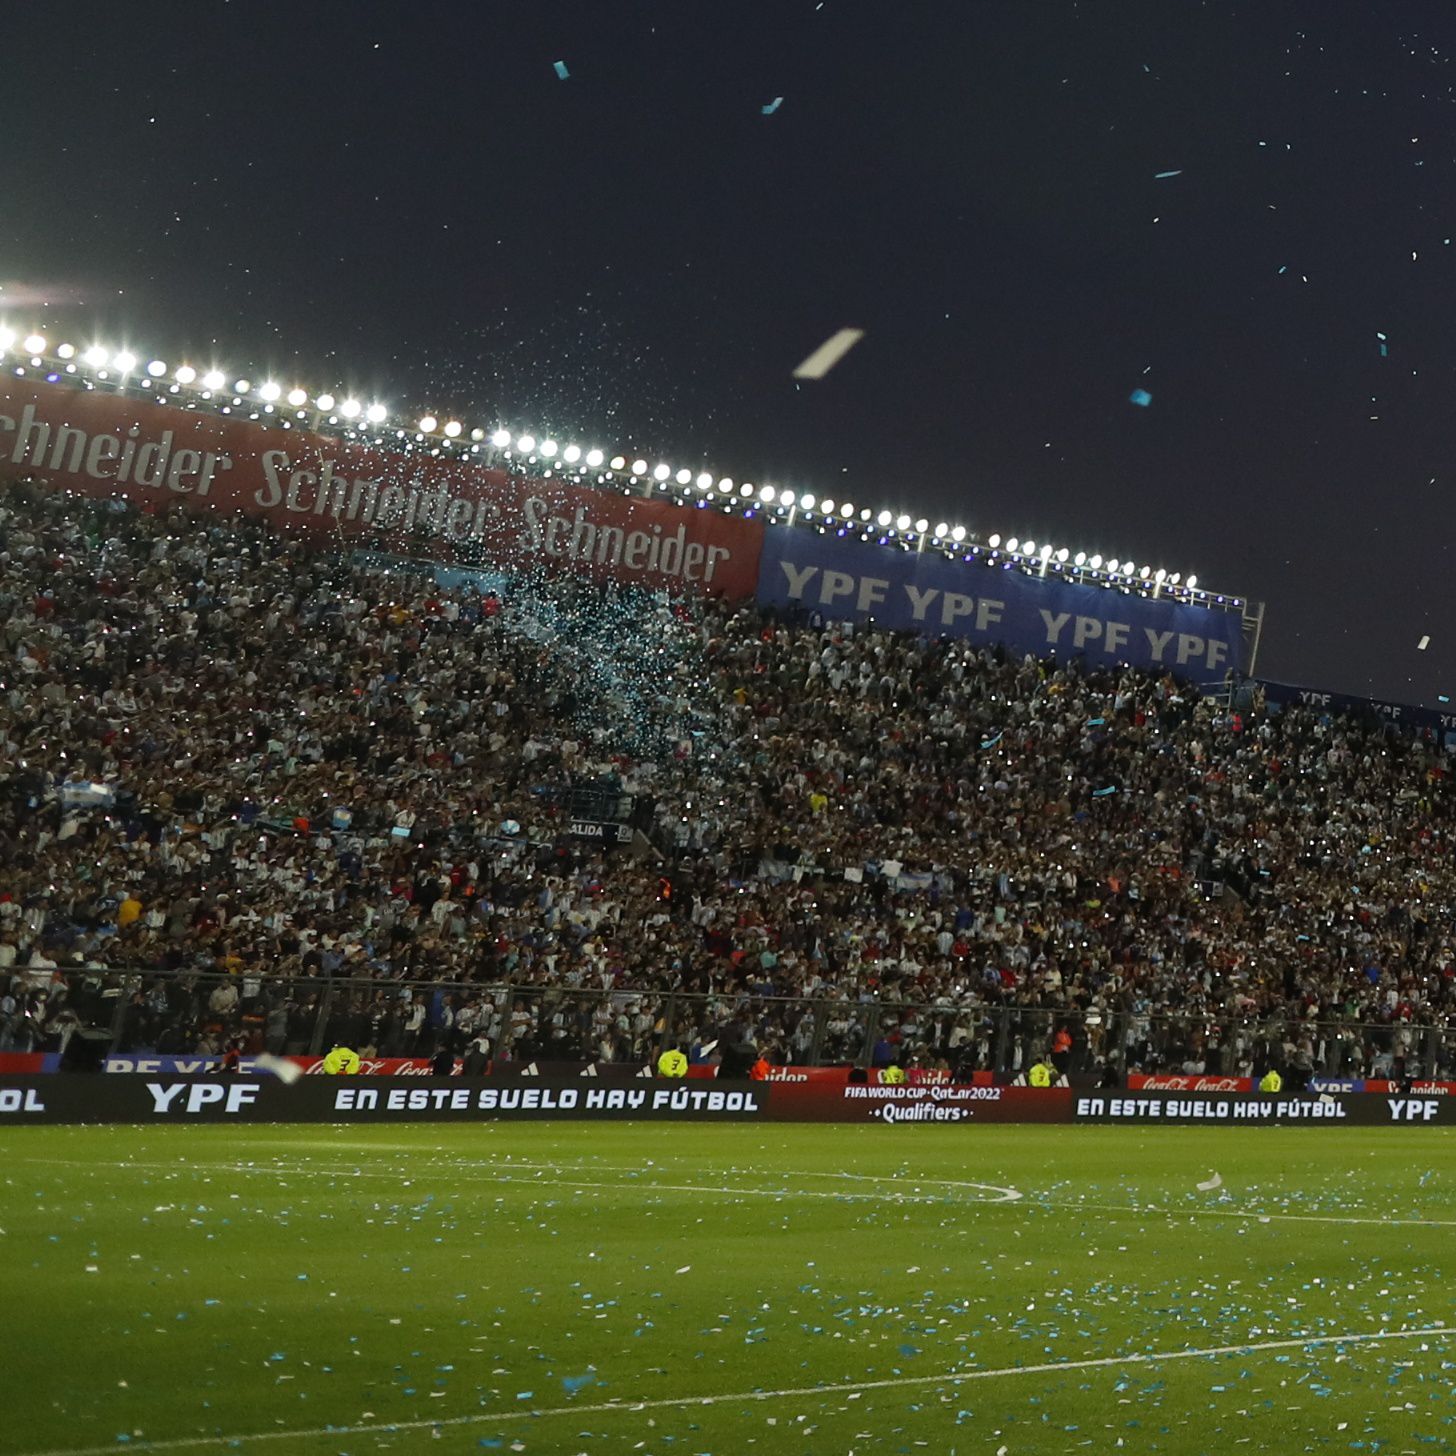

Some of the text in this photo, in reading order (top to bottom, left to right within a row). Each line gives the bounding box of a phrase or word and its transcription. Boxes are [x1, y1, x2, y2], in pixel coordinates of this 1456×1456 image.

[255, 451, 500, 543] Schneider
[522, 497, 730, 583] Schneider
[780, 561, 888, 612] YPF
[904, 584, 1005, 631] YPF
[1039, 608, 1131, 655] YPF
[1142, 631, 1229, 671] YPF
[106, 1060, 161, 1074] DE
[146, 1084, 260, 1112] YPF
[335, 1087, 758, 1111] EN ESTE SUELO HAY FÚTBOL
[882, 1103, 960, 1121] Qualifiers
[1077, 1099, 1346, 1117] EN ESTE SUELO HAY FÚTBOL
[1388, 1100, 1439, 1120] YPF
